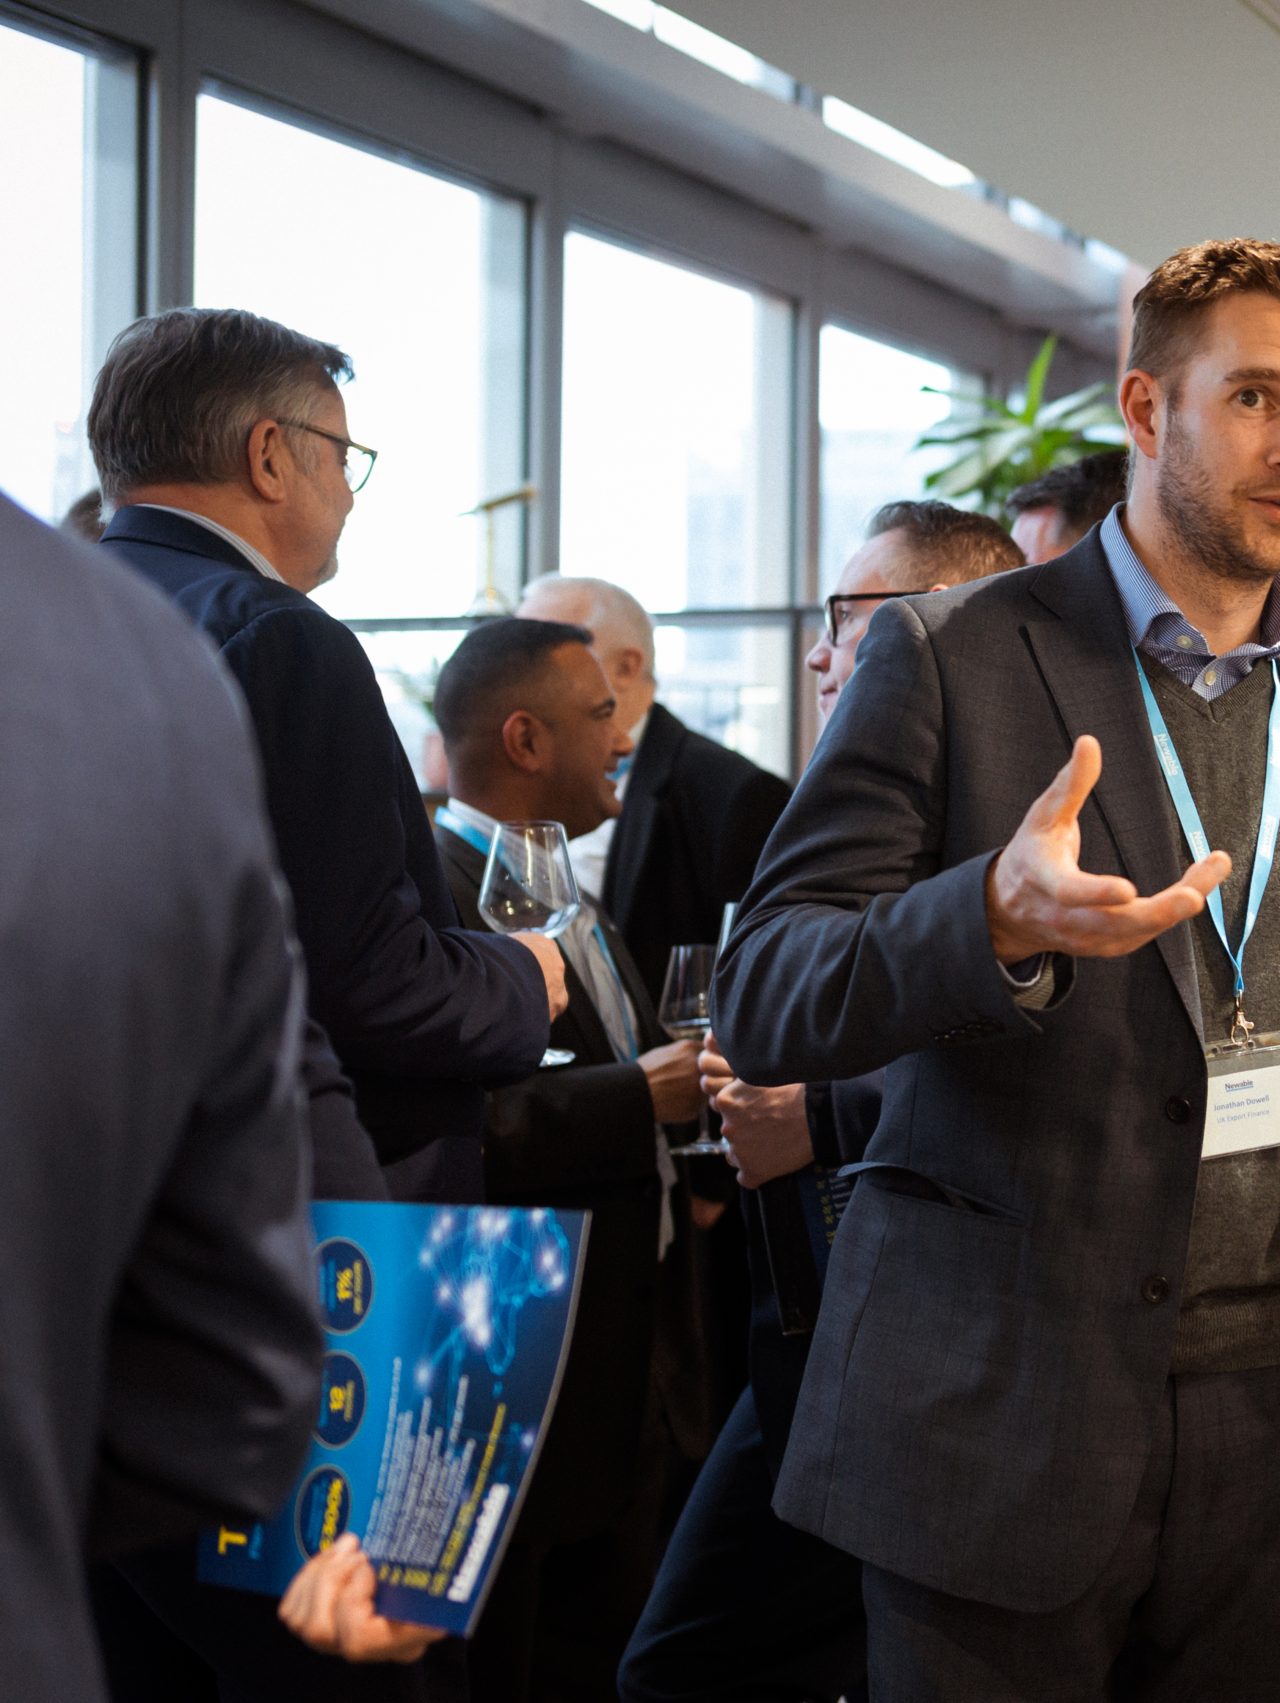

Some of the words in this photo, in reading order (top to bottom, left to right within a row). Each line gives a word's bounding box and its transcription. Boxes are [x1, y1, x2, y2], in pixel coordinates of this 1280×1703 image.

[1157, 733, 1178, 776] Newable
[1225, 1080, 1254, 1091] Newable
[1214, 1101, 1245, 1111] Jonathan
[1246, 1095, 1270, 1106] Dowell
